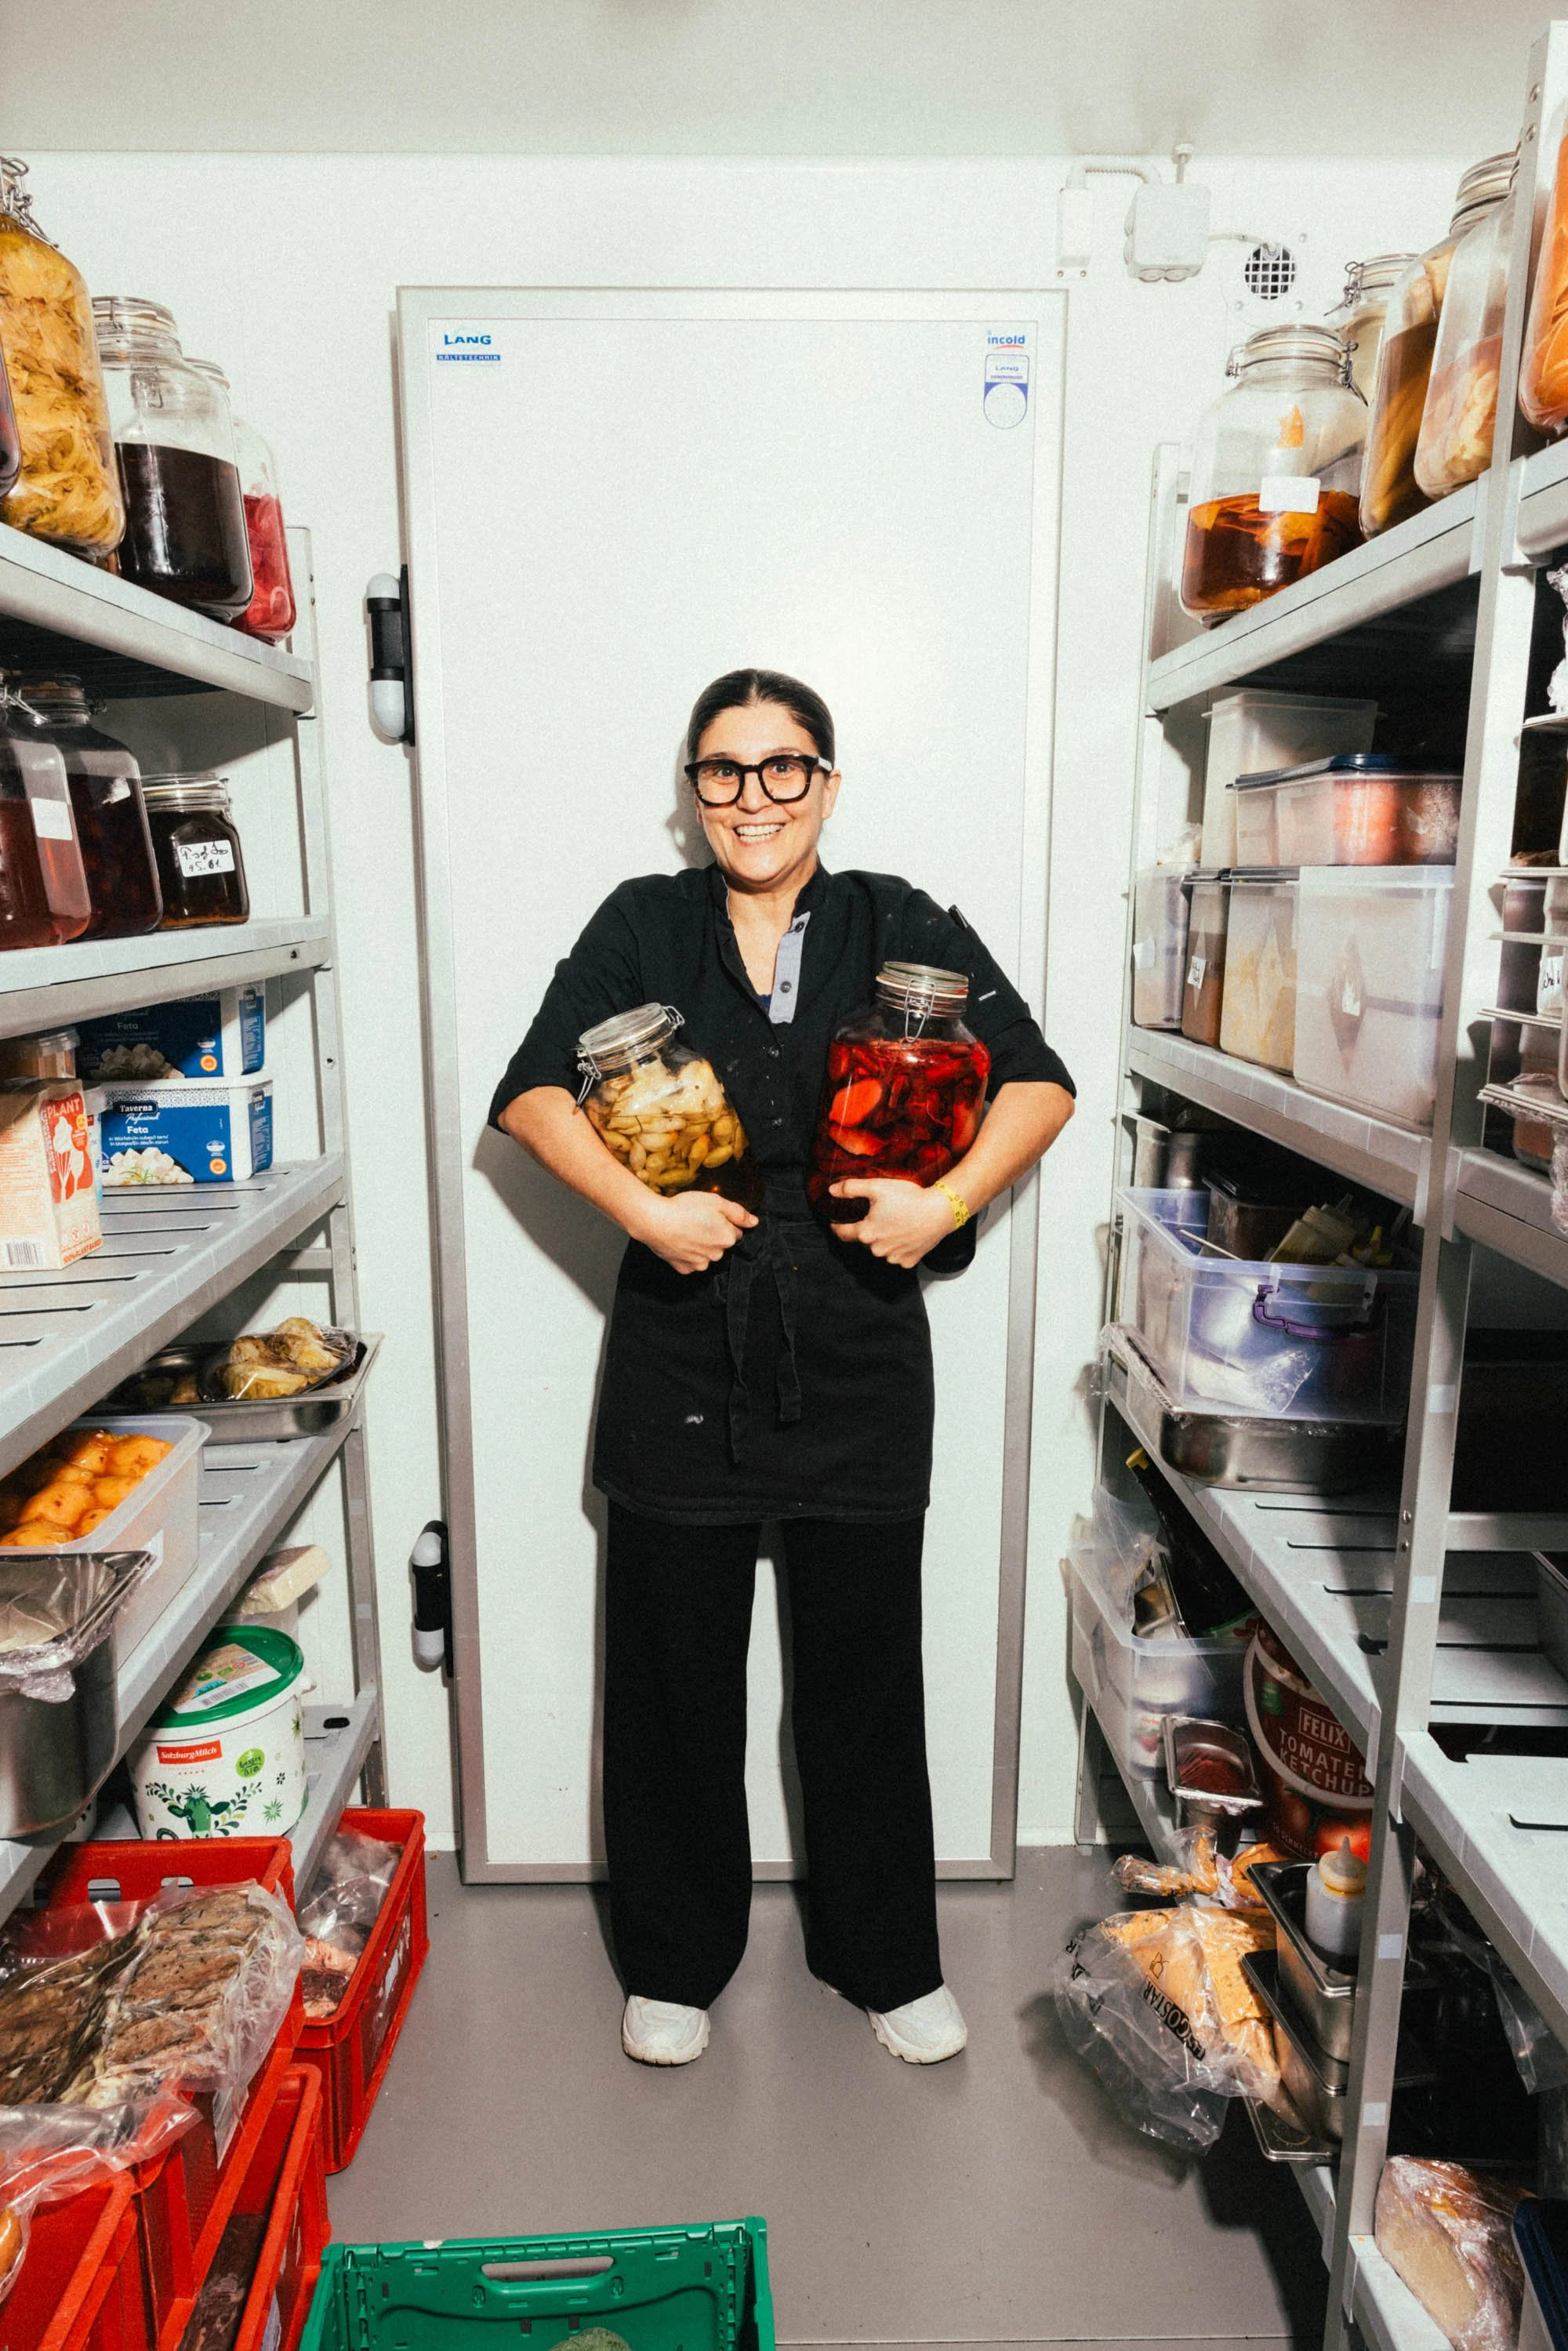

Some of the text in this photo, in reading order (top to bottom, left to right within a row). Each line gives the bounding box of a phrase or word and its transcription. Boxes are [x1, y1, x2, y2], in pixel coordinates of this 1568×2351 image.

[444, 334, 492, 345] LANG
[987, 331, 1025, 344] incold
[47, 1098, 81, 1118] PLANT
[127, 1126, 149, 1134] Feta
[1303, 1714, 1347, 1747] FELIX
[161, 1747, 217, 1760] SalzburgMilch
[1279, 1747, 1371, 1798] KETCHUP
